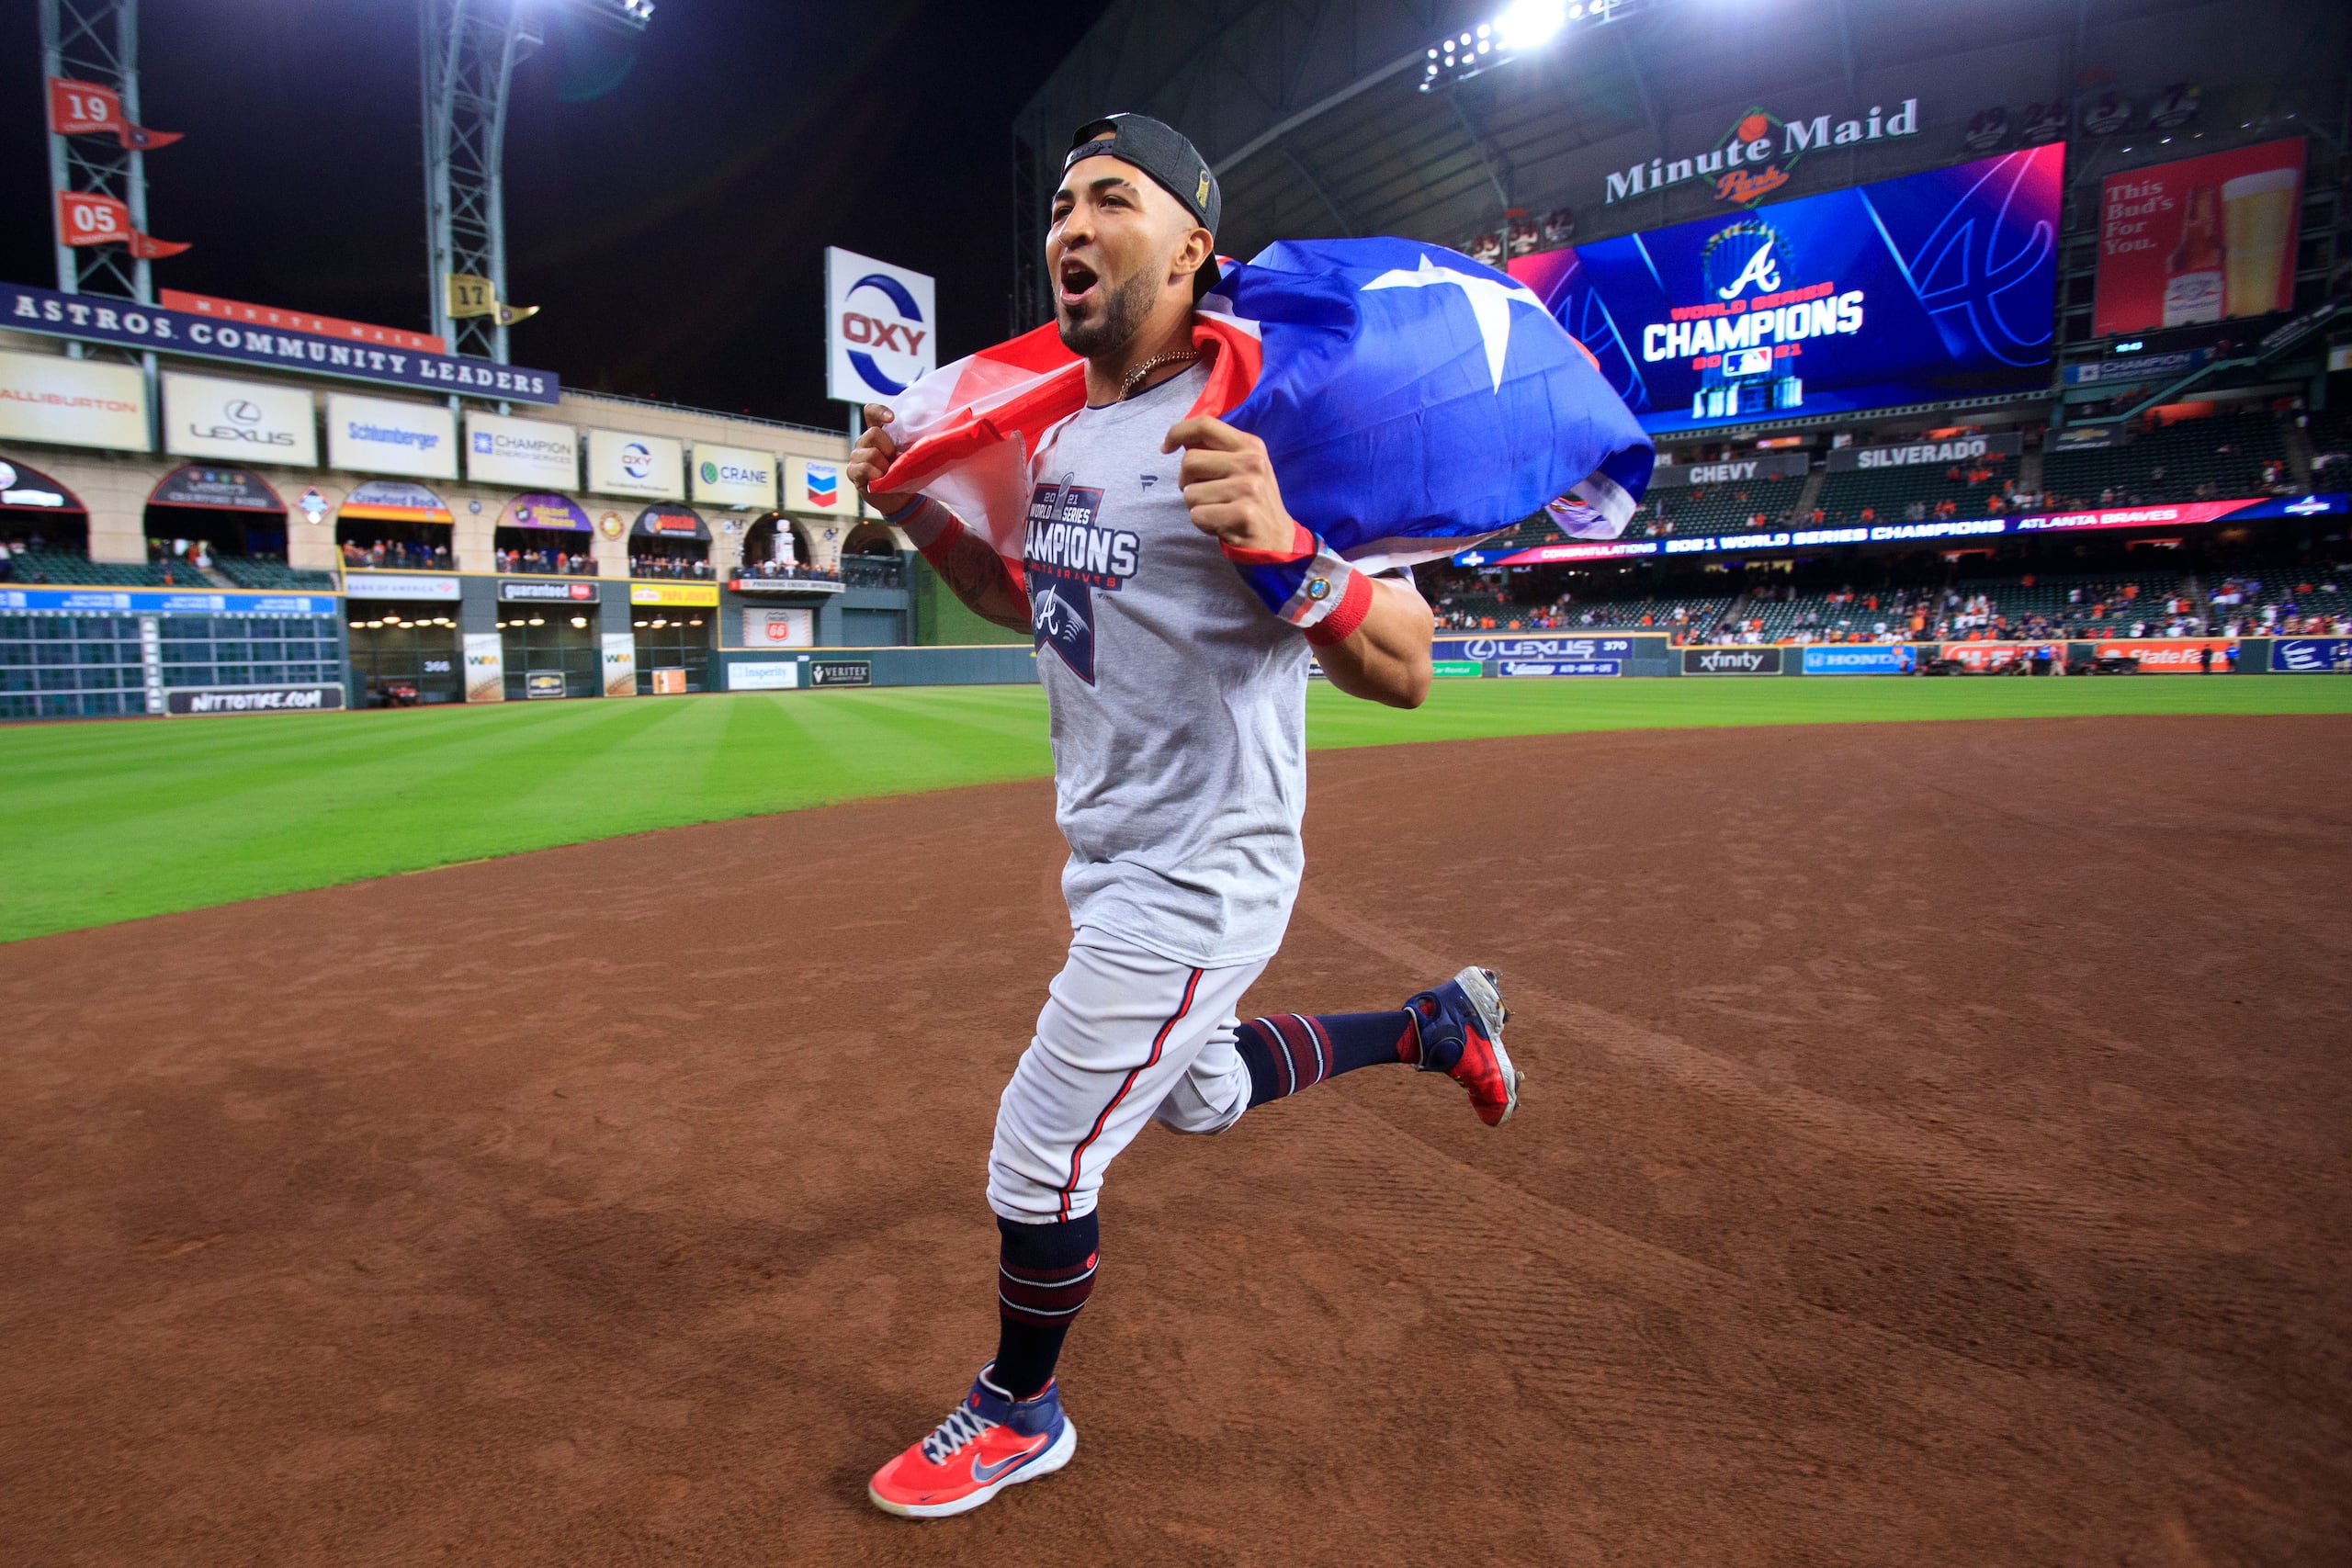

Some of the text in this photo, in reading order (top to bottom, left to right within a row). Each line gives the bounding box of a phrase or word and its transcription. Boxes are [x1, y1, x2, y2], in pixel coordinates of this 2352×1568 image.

[68, 94, 108, 122] 19
[1605, 97, 1920, 204] Minute Maid
[1714, 165, 1788, 202] Park
[2106, 180, 2164, 202] This
[74, 204, 117, 233] 05
[2107, 194, 2175, 221] Bud's
[2105, 221, 2147, 239] For
[2104, 238, 2158, 255] You.
[458, 286, 484, 306] 17
[1670, 281, 1835, 321] WORLD SERIES
[196, 300, 422, 347] MINUTE MAID
[842, 311, 927, 356] OXY
[1643, 289, 1864, 363] CHAMPIONS
[15, 295, 545, 395] ASTROS COMMUNITY LEADERS
[189, 423, 295, 446] LEXUS
[348, 422, 439, 450] Schlumberger
[495, 434, 571, 455] CHAMPION
[621, 455, 653, 466] OXY
[1858, 440, 1987, 469] SILVERADO
[720, 466, 768, 484] CRANE
[1689, 461, 1758, 484] CHEVY
[1044, 492, 1079, 505] 20 21
[1029, 503, 1091, 525] WORLD SERIES
[1541, 508, 2177, 559] CONGRATULATIONS 2021 WORLD SERIES CHAMPIONS ATLANTA BRAVES
[1024, 520, 1137, 576] AMPIONS
[1056, 570, 1116, 588] BRAVES
[769, 625, 786, 637] 66
[1498, 640, 1629, 655] LEXUS 370
[1700, 649, 1764, 671] xfinity
[1826, 653, 1911, 666] HONDA
[824, 667, 868, 677] VERITEX
[190, 690, 322, 713] NITTOTIRE.COM
